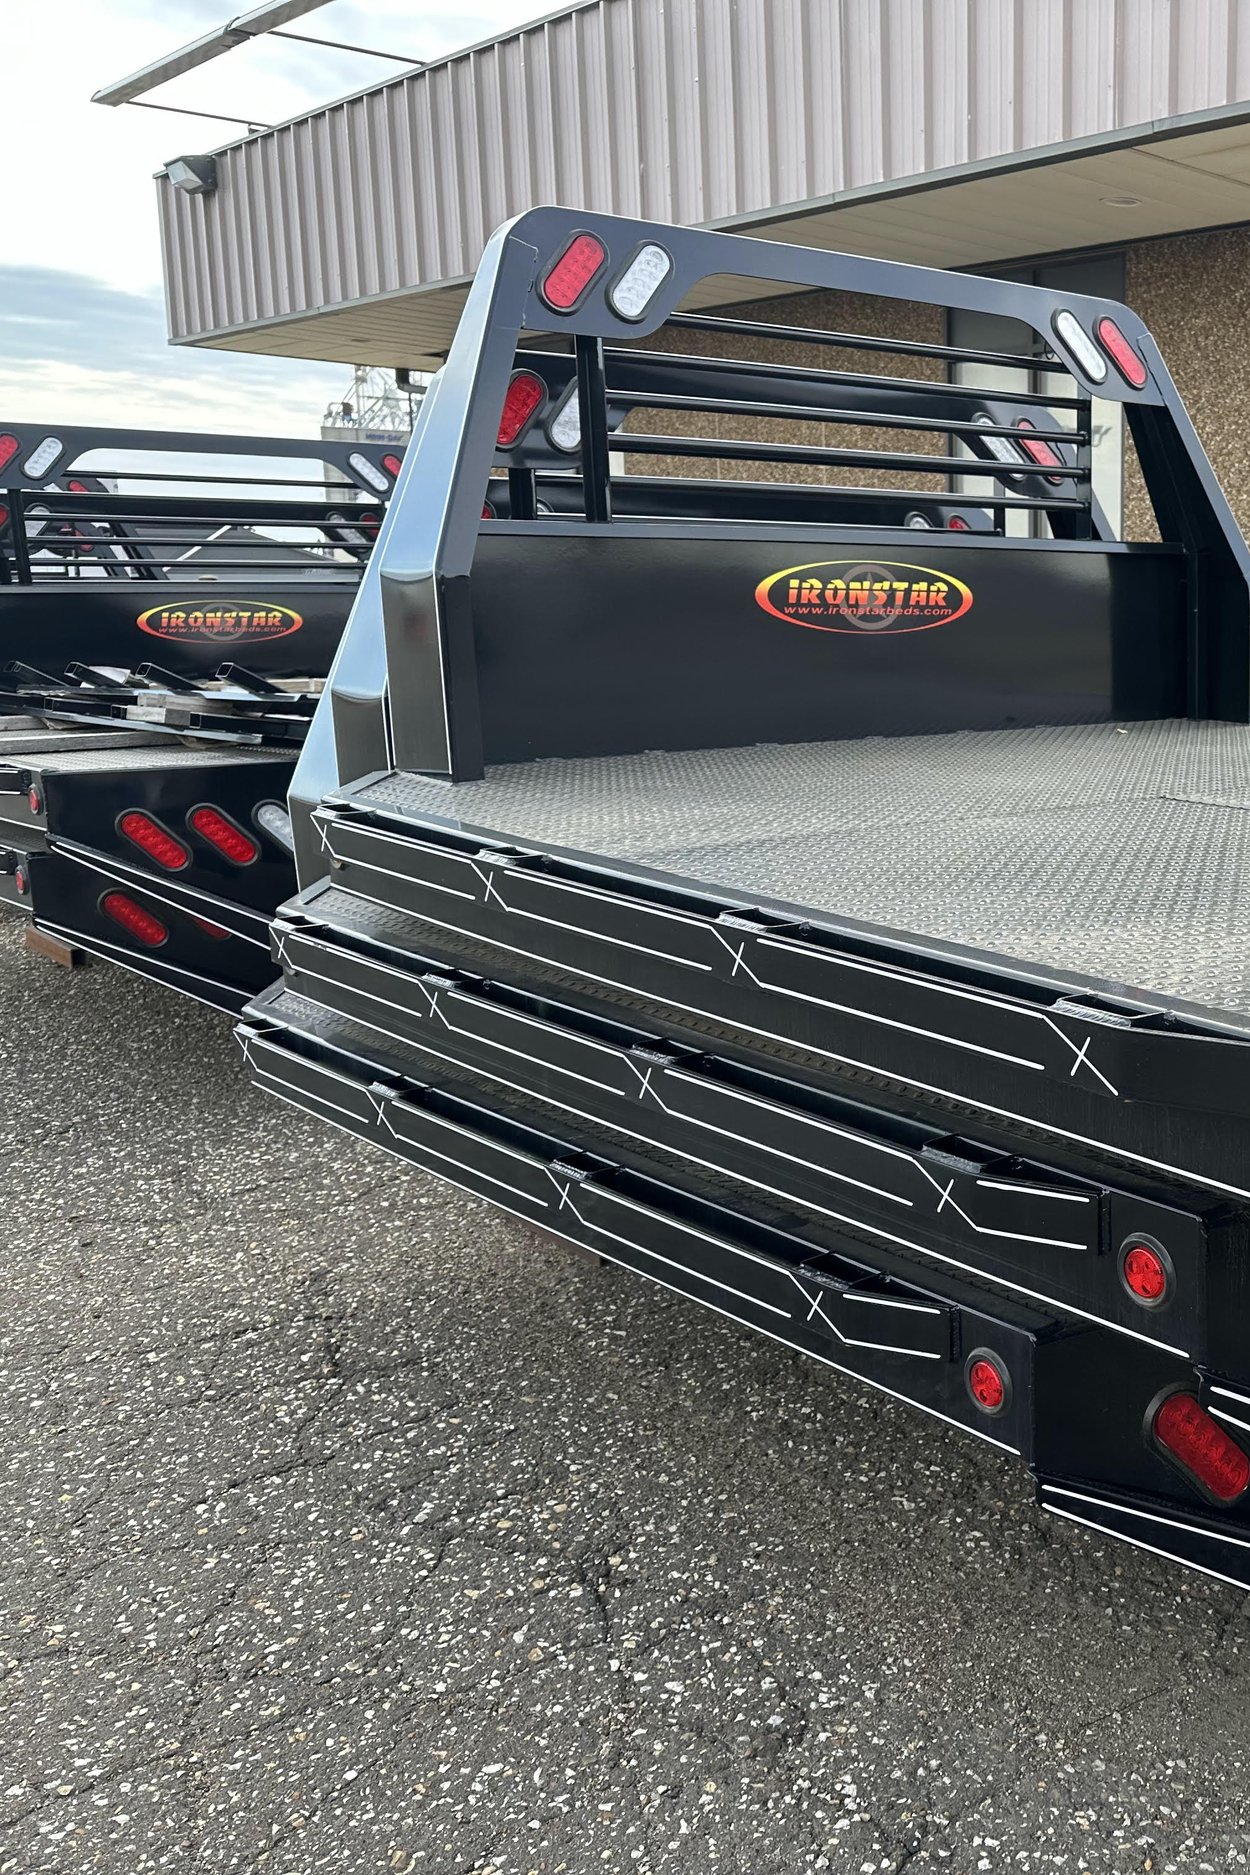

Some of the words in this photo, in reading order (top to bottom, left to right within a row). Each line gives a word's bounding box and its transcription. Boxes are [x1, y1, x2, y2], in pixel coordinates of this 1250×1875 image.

[788, 578, 949, 606] IRONSTAR
[784, 605, 952, 616] www.ironstarbeds.com
[160, 611, 283, 627] IRONSTAR
